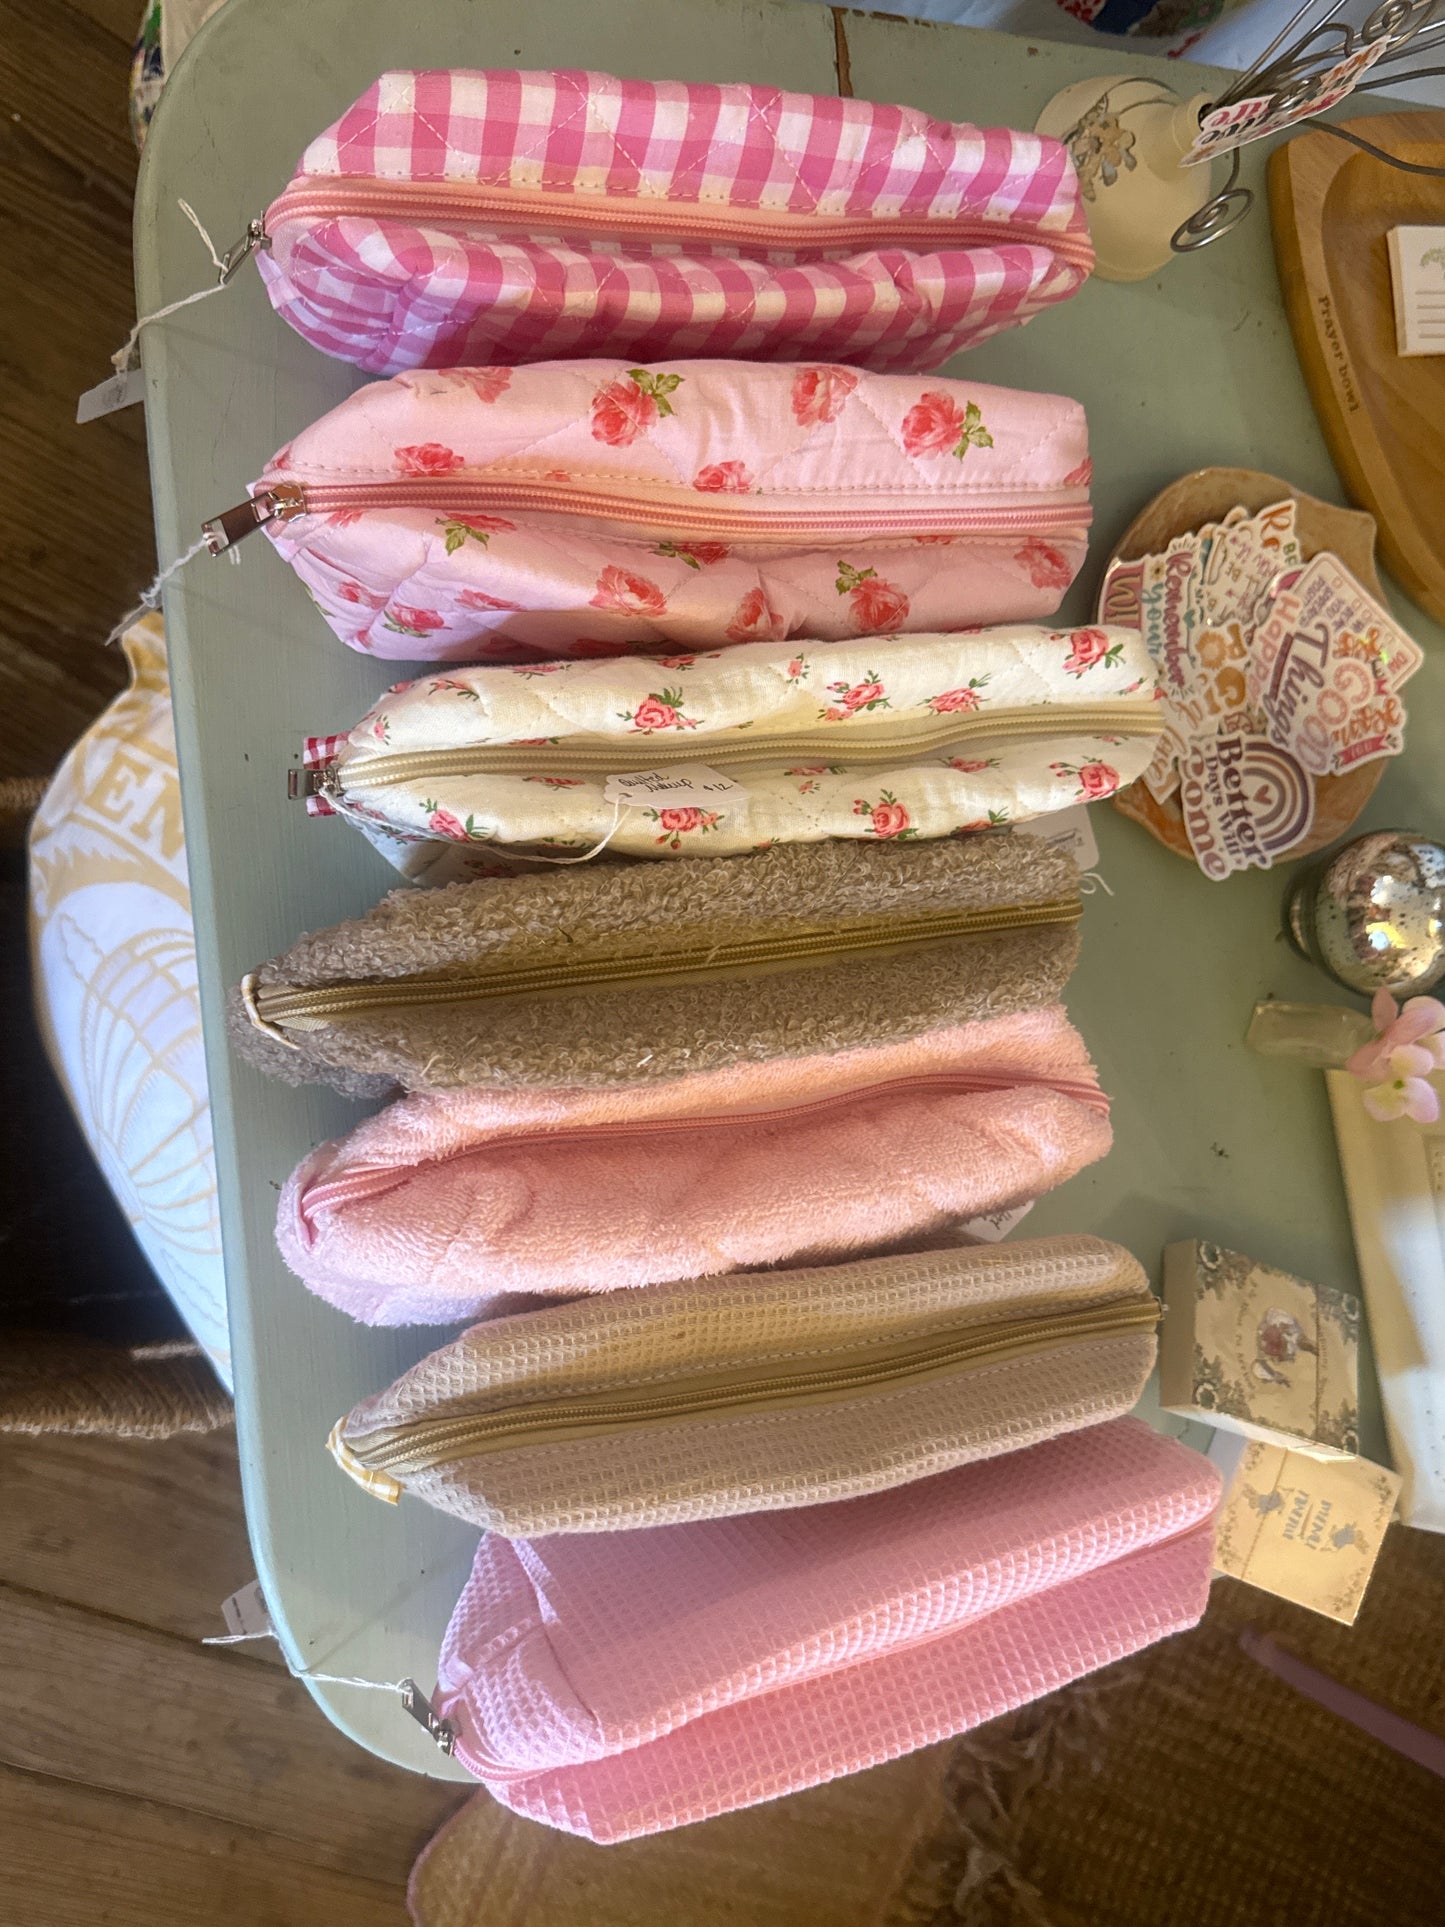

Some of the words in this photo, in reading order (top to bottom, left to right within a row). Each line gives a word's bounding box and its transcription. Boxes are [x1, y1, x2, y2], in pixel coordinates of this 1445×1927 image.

[1318, 295, 1344, 360] Prayer
[1338, 363, 1360, 412] bowl
[1141, 583, 1165, 654] your
[1163, 552, 1194, 687] Remember
[1263, 622, 1330, 746] Things
[1295, 662, 1371, 771] GOOD
[1182, 744, 1226, 877] Come
[1204, 756, 1224, 807] Days
[1217, 810, 1240, 856] Will
[1216, 737, 1268, 864] Better
